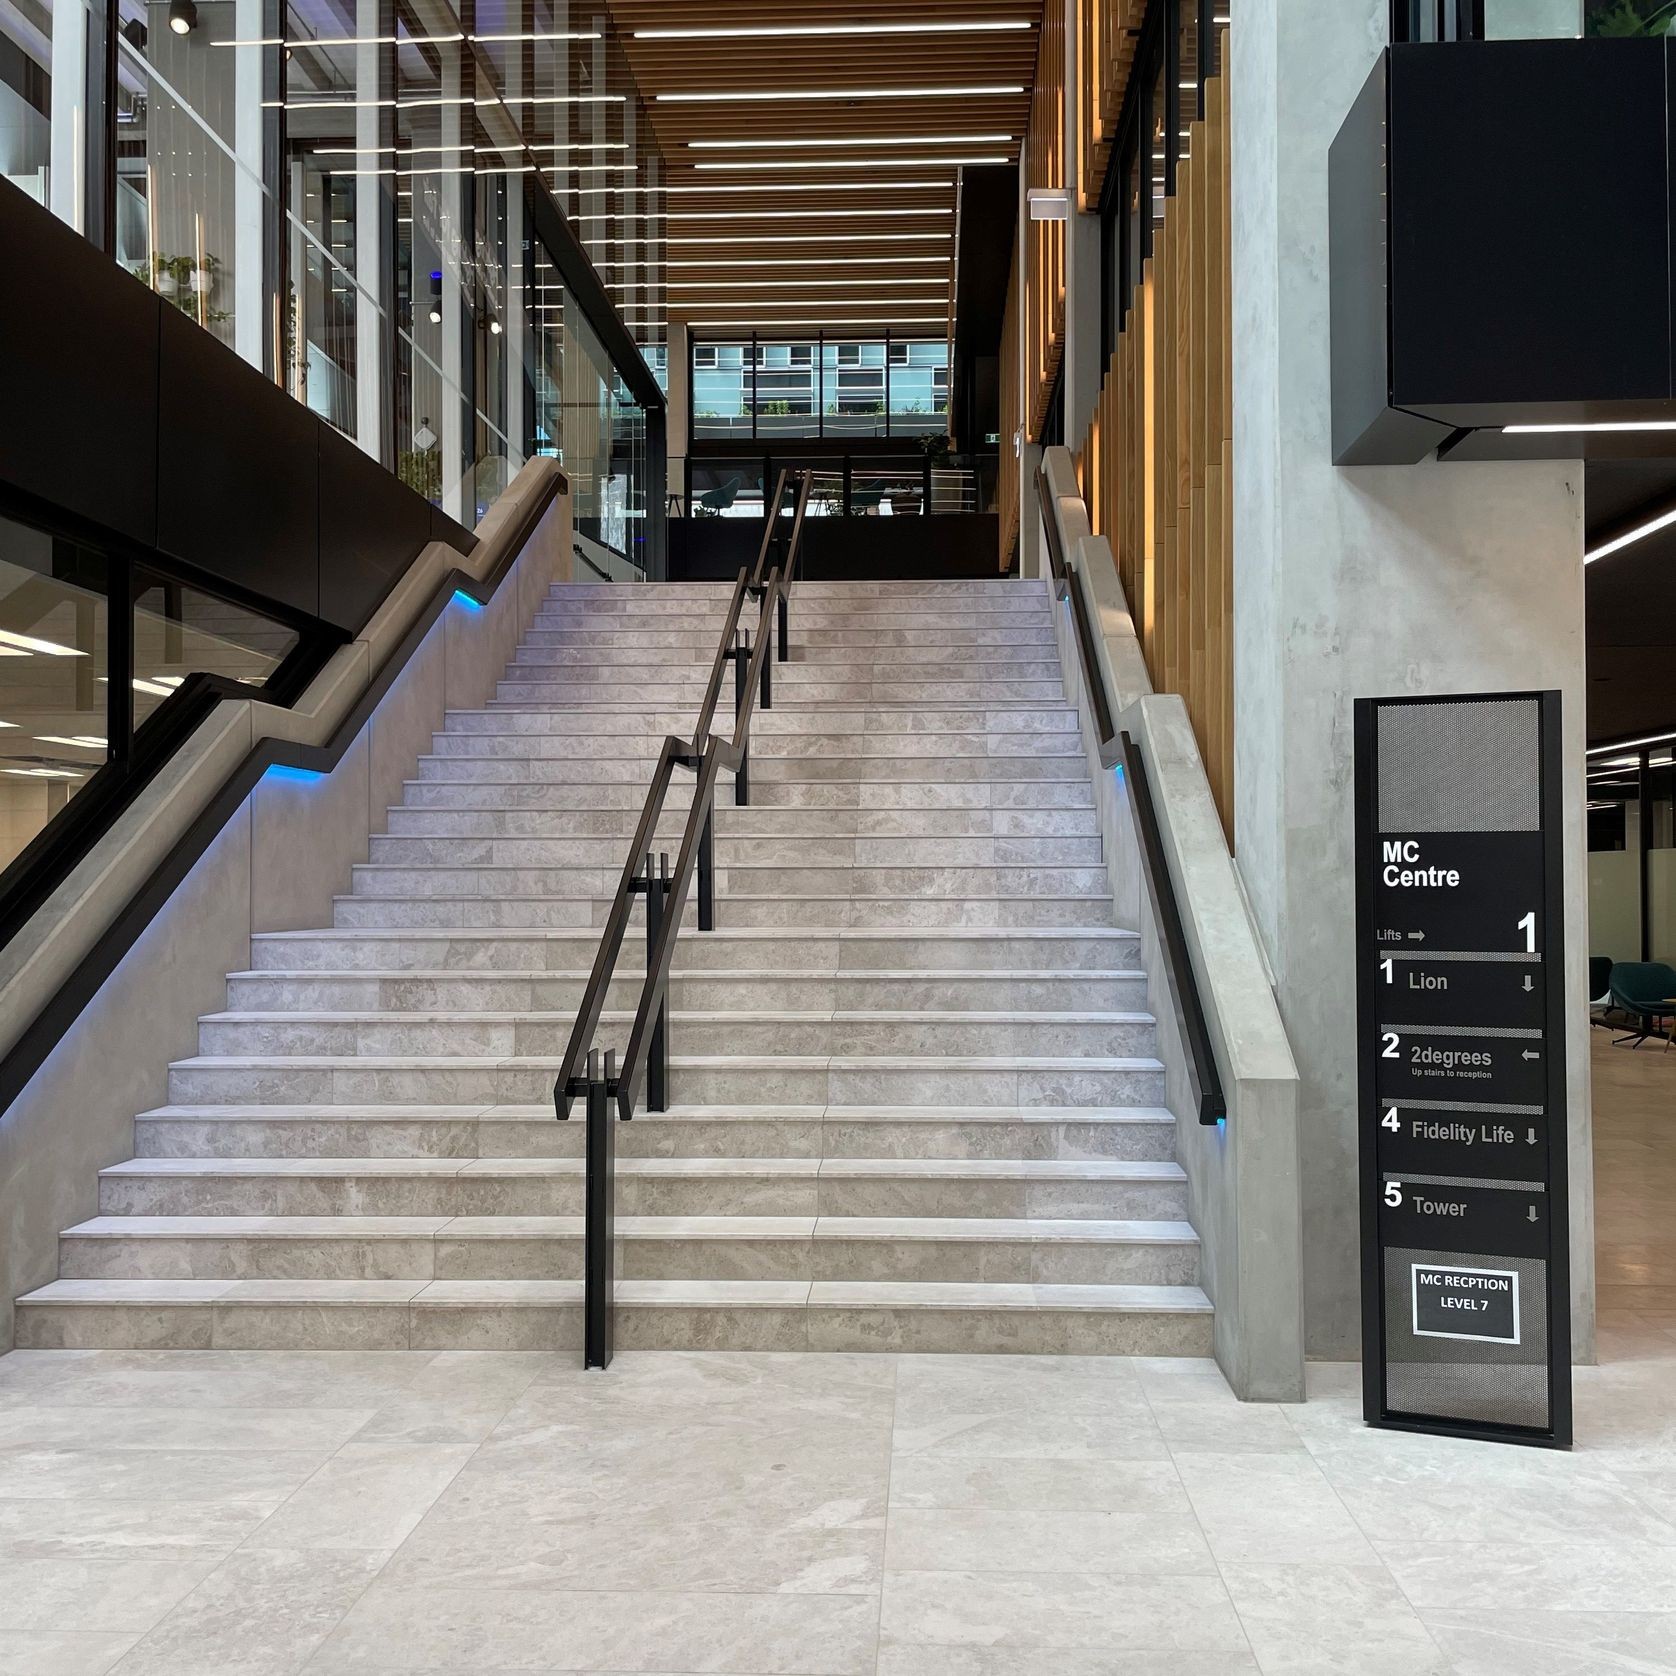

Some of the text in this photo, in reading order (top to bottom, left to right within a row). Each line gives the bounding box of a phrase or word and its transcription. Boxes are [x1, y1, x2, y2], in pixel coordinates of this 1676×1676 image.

[1382, 840, 1420, 863] MC
[1382, 864, 1460, 887] Centre
[1376, 929, 1402, 941] Lifts
[1517, 912, 1535, 953] 1
[1379, 958, 1448, 990] 1 Lion
[1381, 1032, 1492, 1068] 2 2degrees
[1411, 1067, 1492, 1080] Up stairs to reception
[1381, 1106, 1515, 1145] 4 Fidelity Life
[1383, 1181, 1467, 1217] 5 Tower
[1420, 1273, 1509, 1291] MC RECPTION
[1440, 1296, 1489, 1311] LEVEL 7
